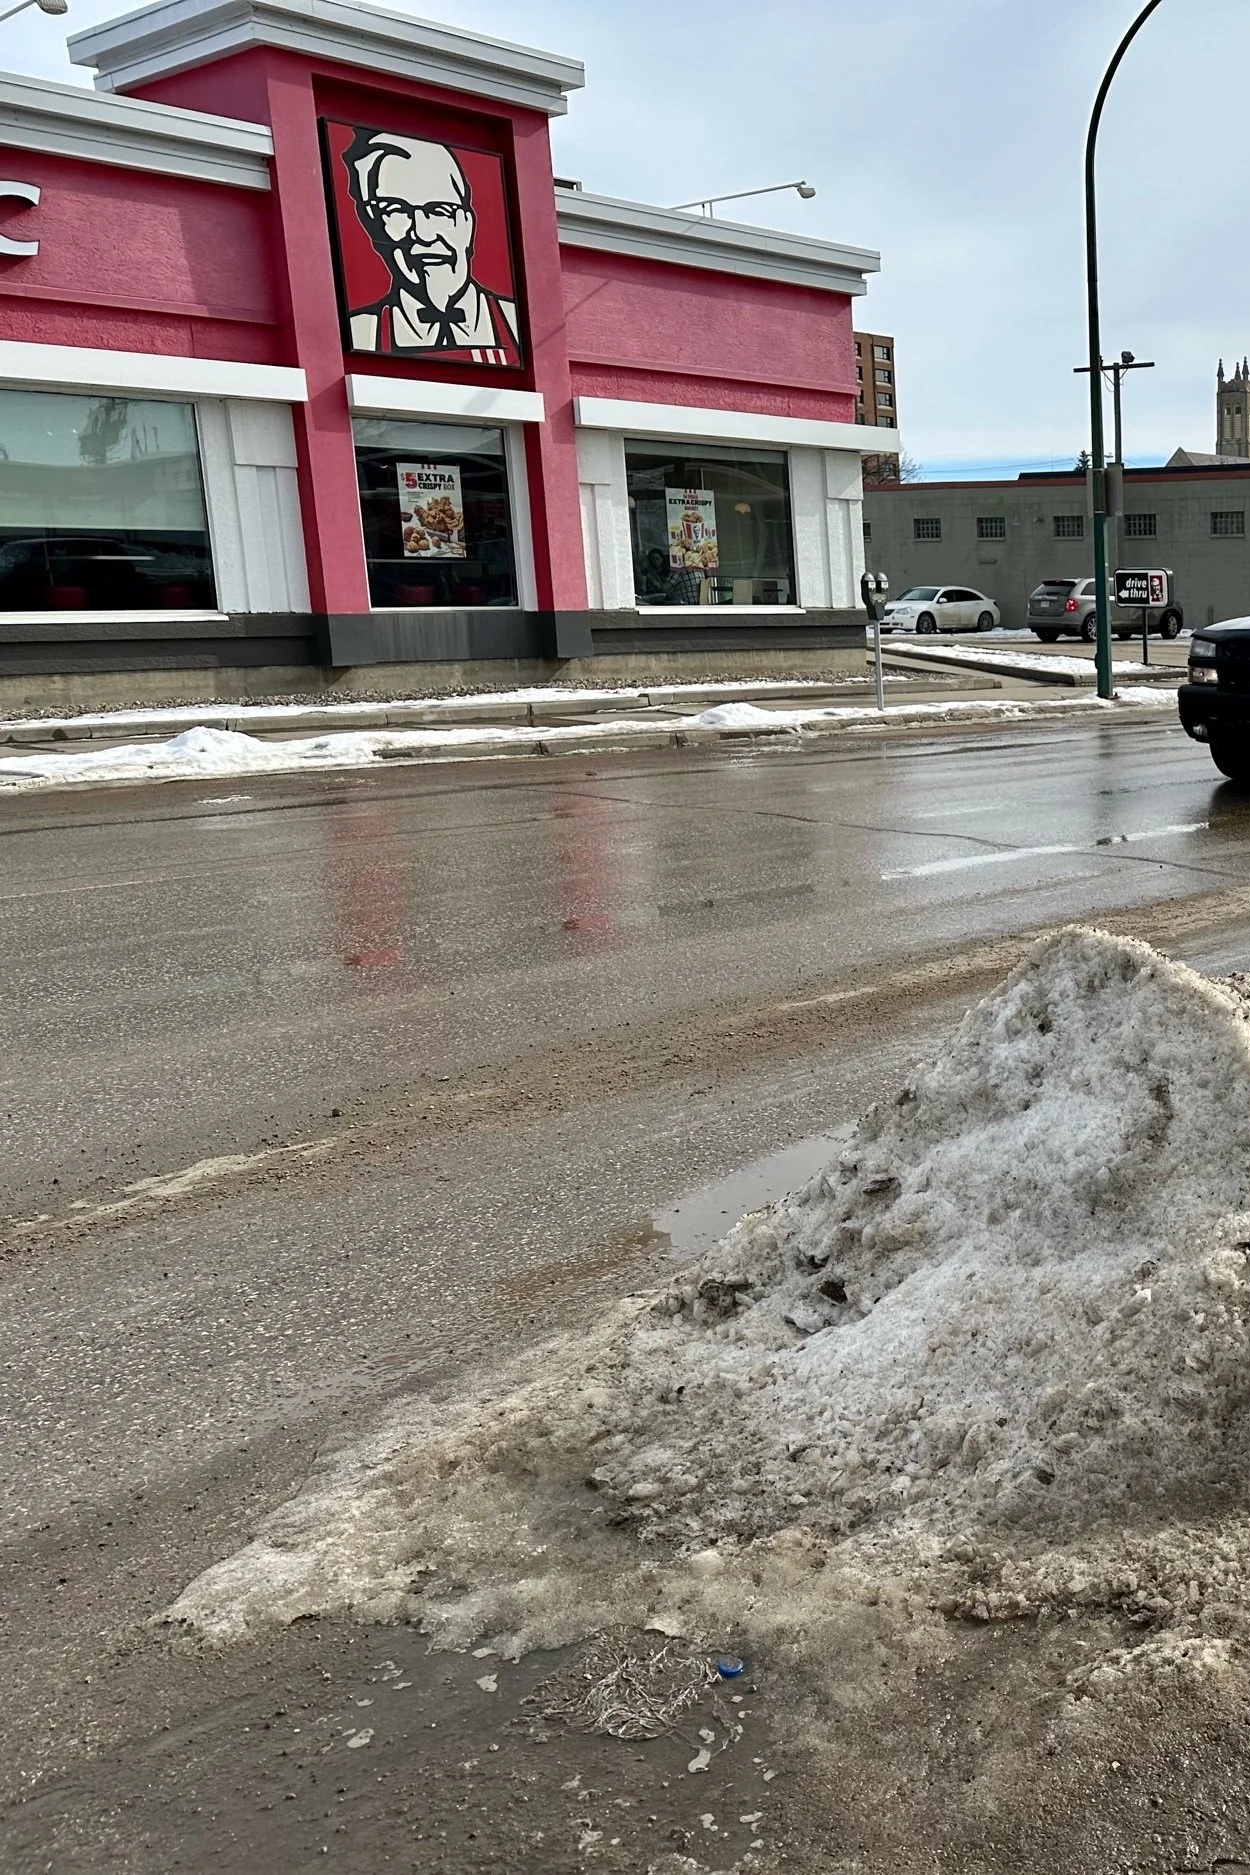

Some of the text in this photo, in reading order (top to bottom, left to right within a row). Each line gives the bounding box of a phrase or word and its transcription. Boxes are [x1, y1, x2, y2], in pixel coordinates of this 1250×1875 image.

[417, 472, 455, 483] EXTRA
[418, 482, 455, 491] CRISPY BOX
[668, 498, 691, 506] EXTRA
[1125, 577, 1147, 588] drive
[1130, 588, 1147, 598] thru
